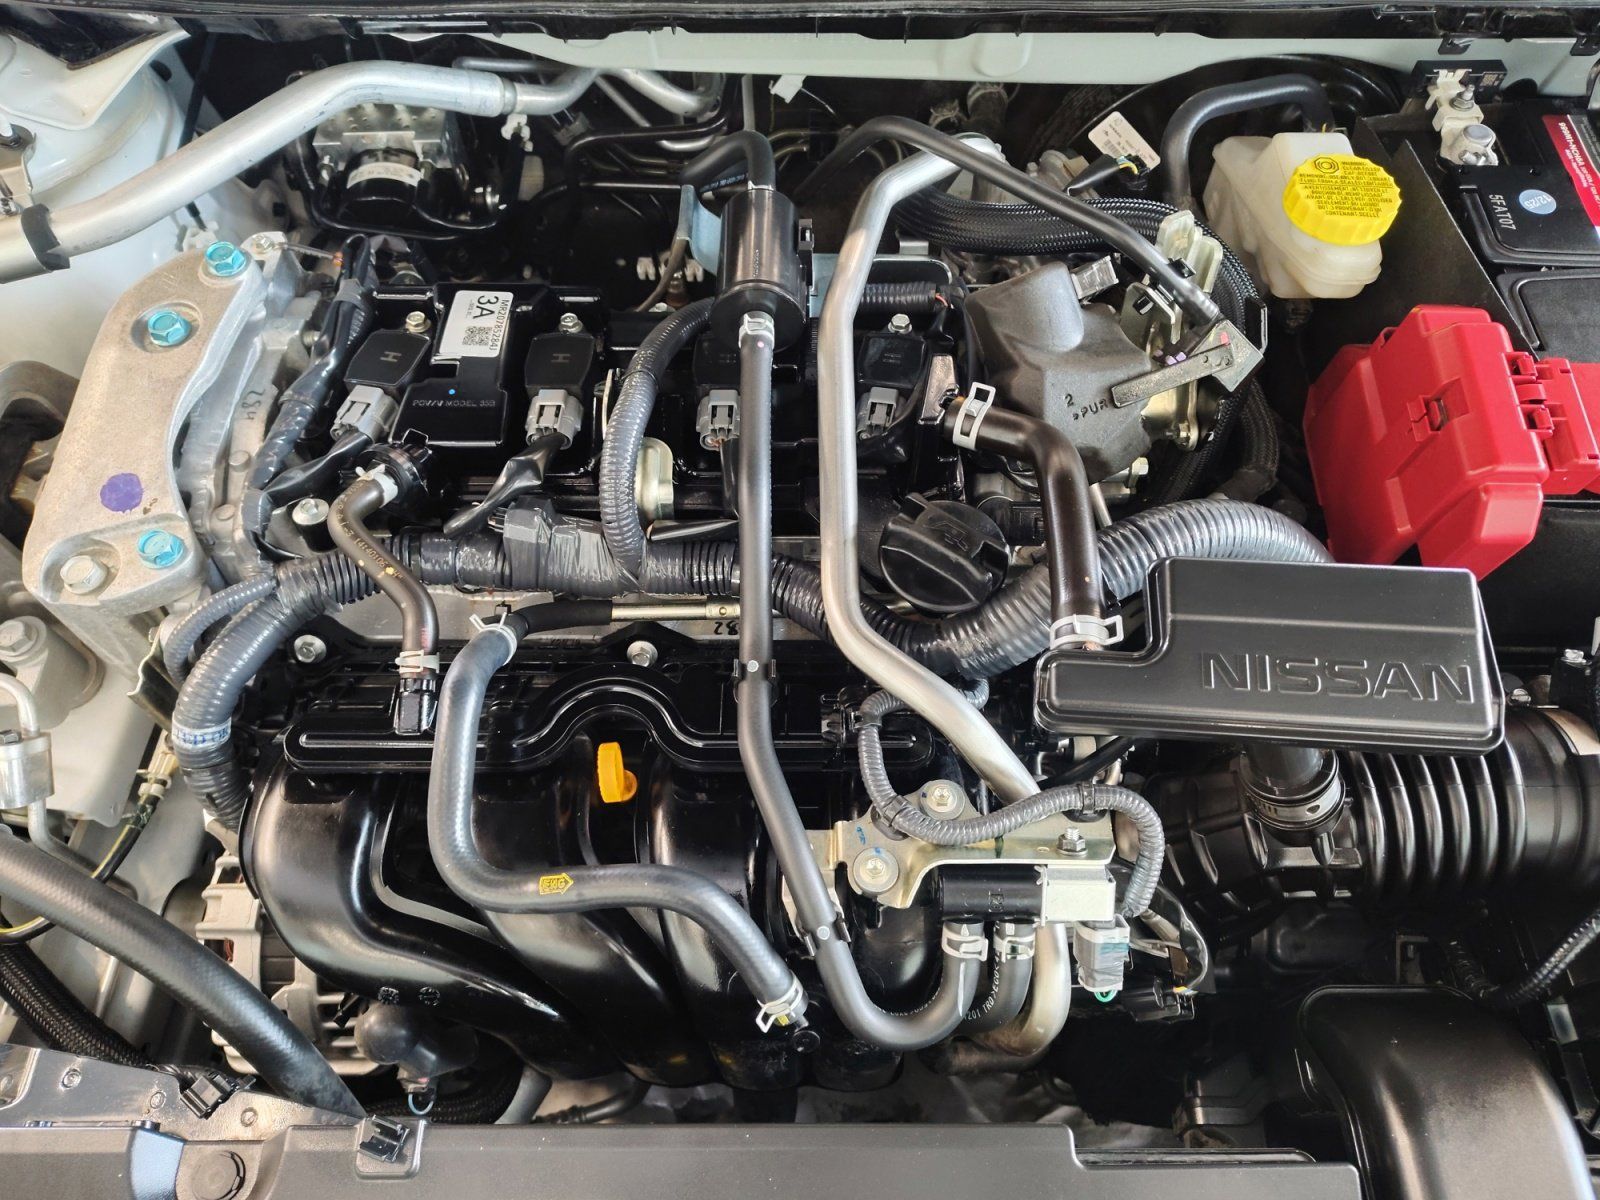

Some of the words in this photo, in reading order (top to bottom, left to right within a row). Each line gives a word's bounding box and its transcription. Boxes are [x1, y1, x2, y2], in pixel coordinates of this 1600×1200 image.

[1488, 194, 1517, 231] 5FAT07
[473, 295, 499, 319] 3A
[1203, 652, 1475, 705] NISSAN
